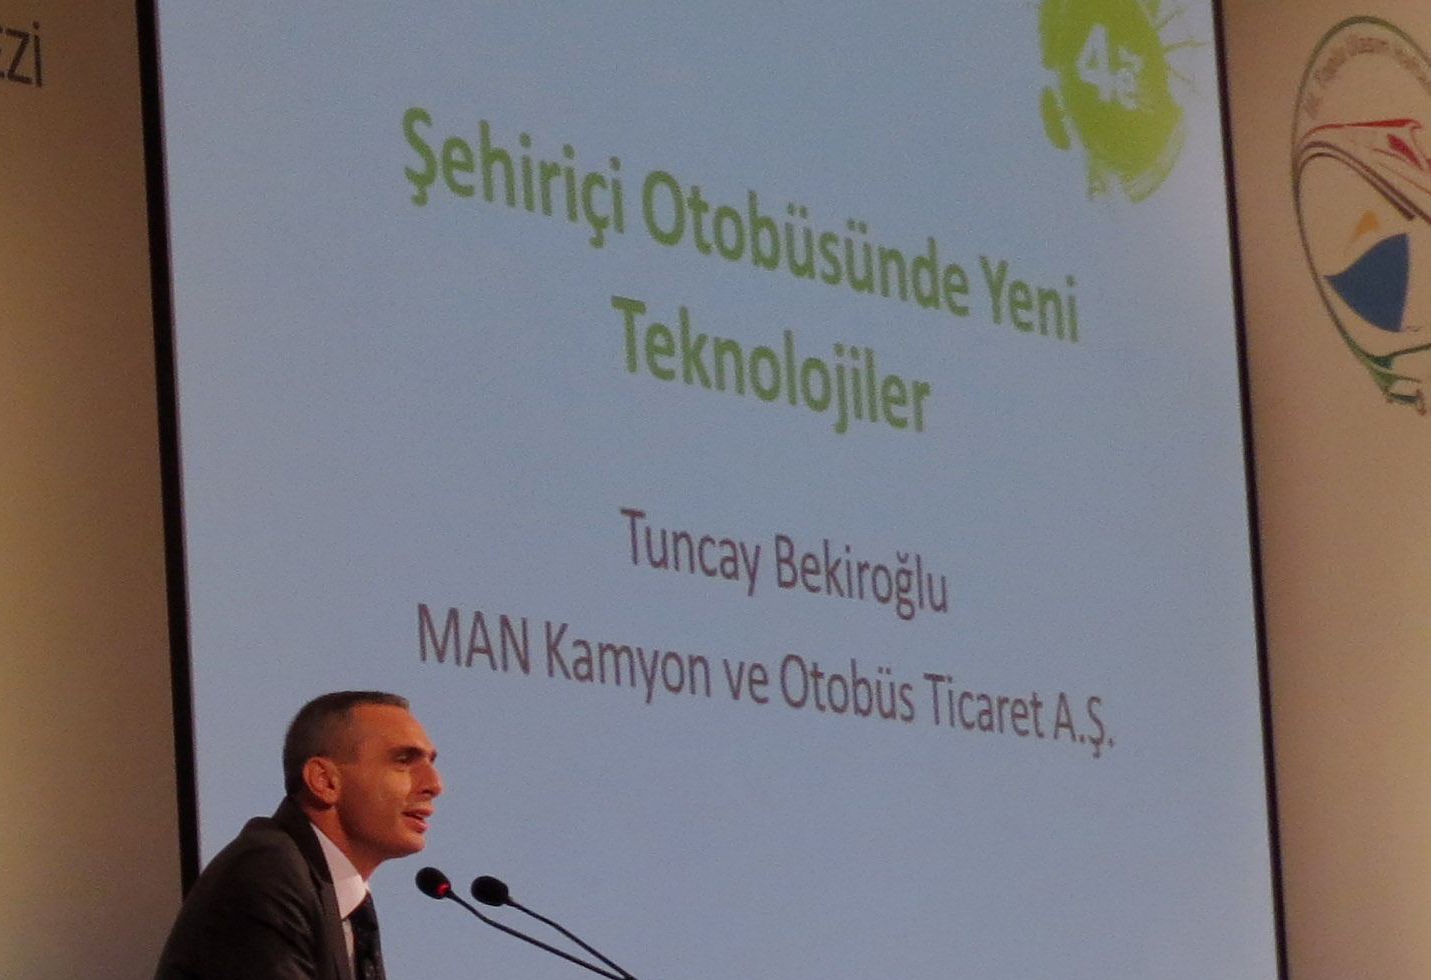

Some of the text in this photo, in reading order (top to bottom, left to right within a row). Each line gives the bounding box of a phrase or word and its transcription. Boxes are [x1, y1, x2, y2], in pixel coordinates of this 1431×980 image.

[402, 107, 1080, 343] Şehiriçi Otobüsünde Yeni
[611, 295, 931, 435] Teknolojiler
[620, 507, 950, 620] Tuncay Bekiroğlu
[416, 603, 1115, 759] MAN Kamyon ve Otobüs Ticaret A.Ş.
